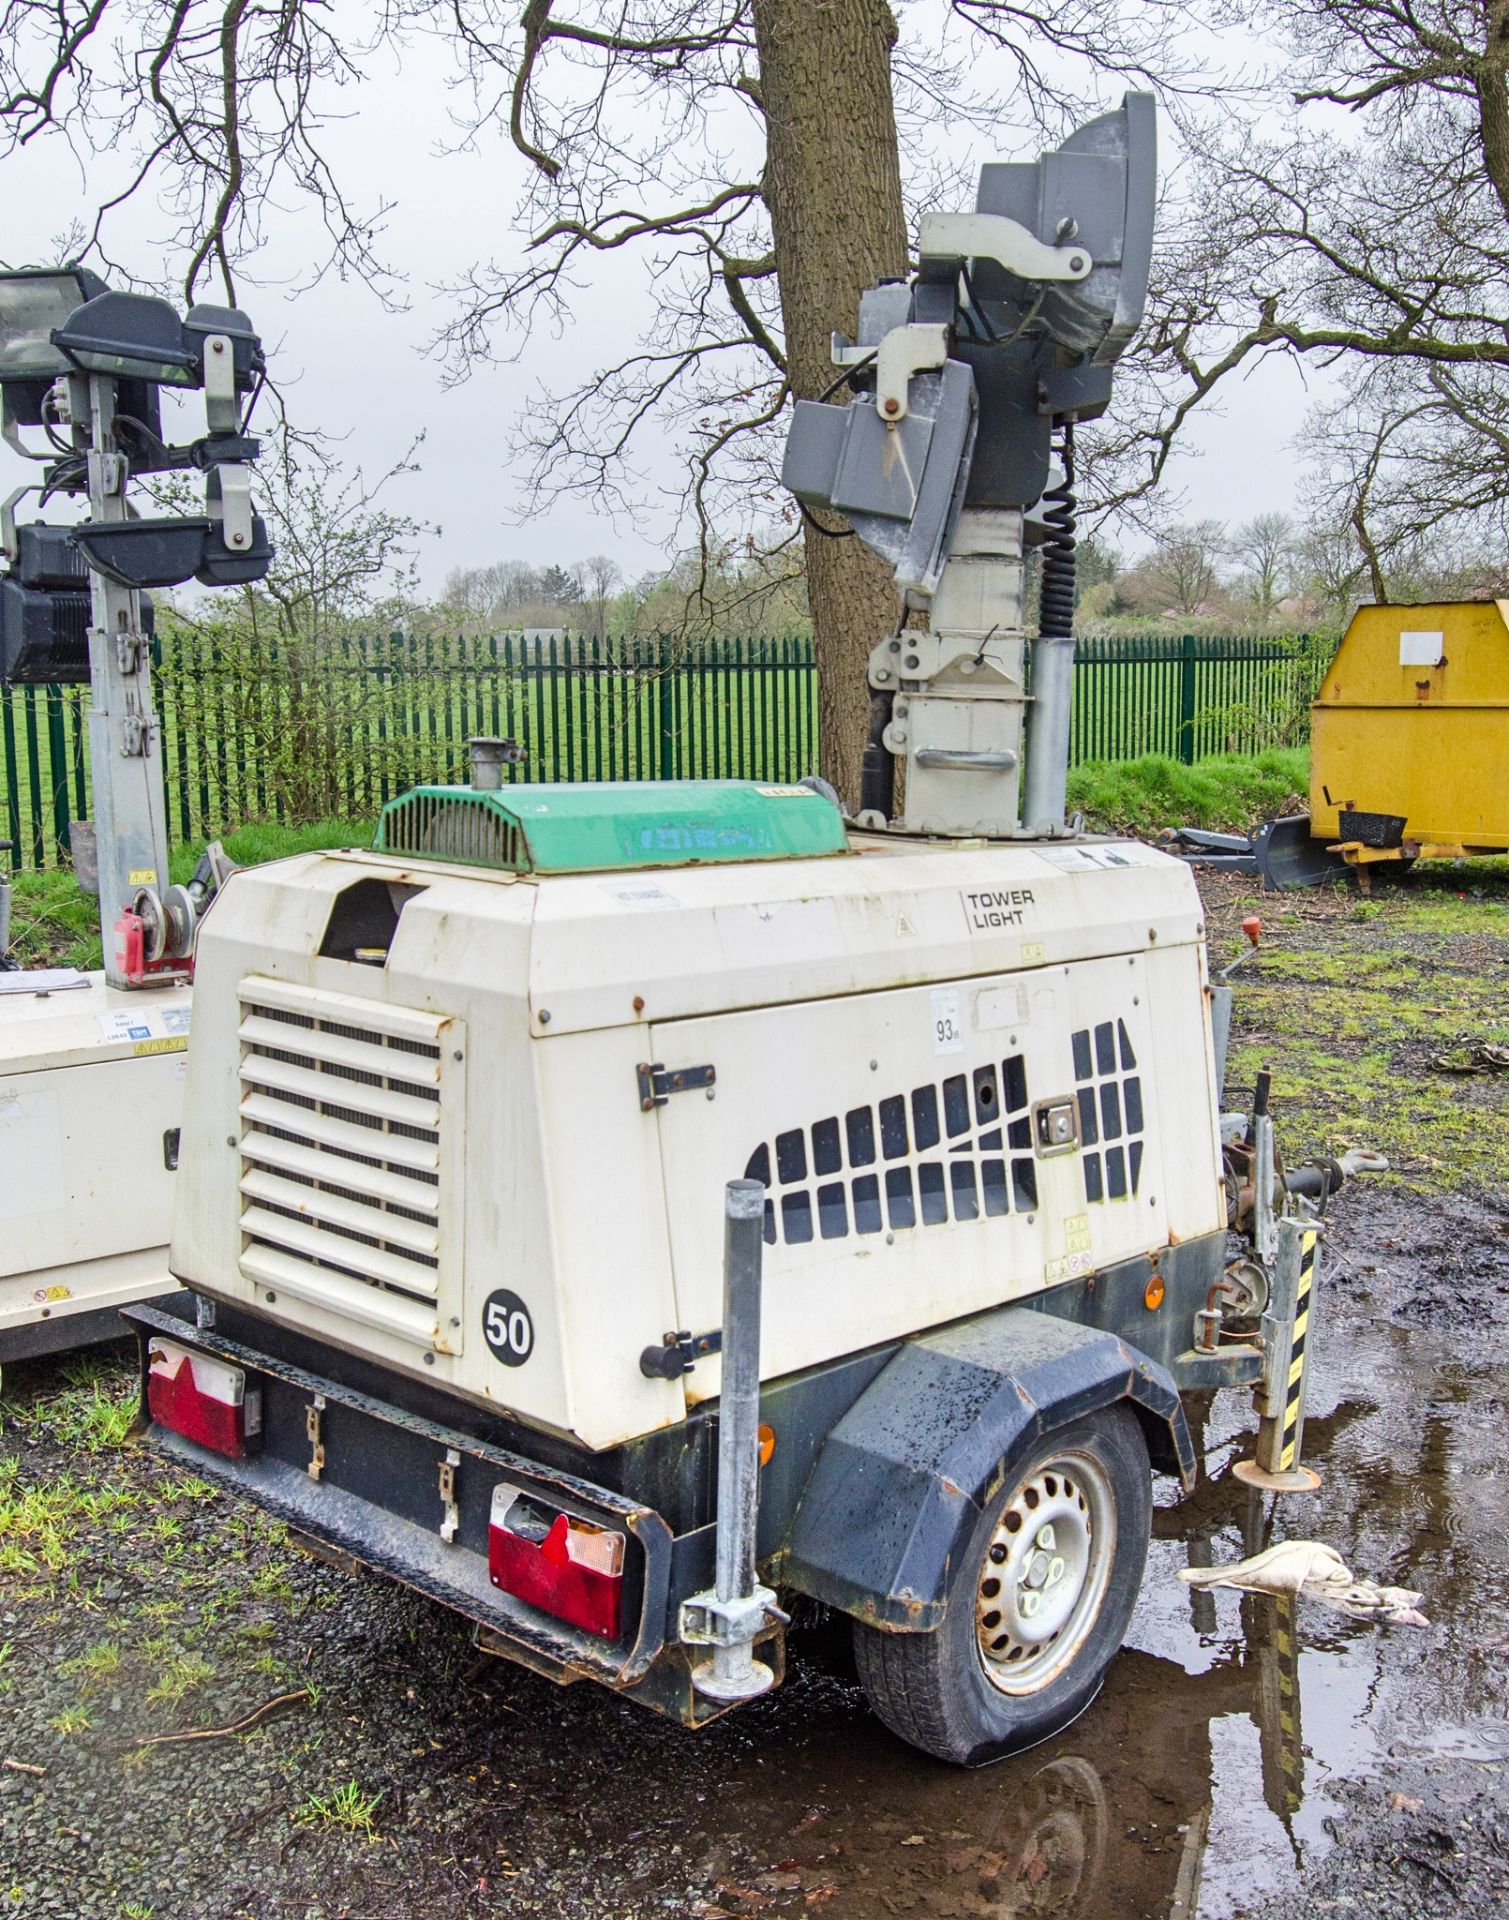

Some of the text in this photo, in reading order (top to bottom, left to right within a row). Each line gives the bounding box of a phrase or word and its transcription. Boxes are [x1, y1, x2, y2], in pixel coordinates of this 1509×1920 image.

[968, 890, 1035, 909] TOWER
[973, 910, 1023, 928] LIGHT
[936, 1019, 953, 1042] 93
[486, 1302, 531, 1355] 50
